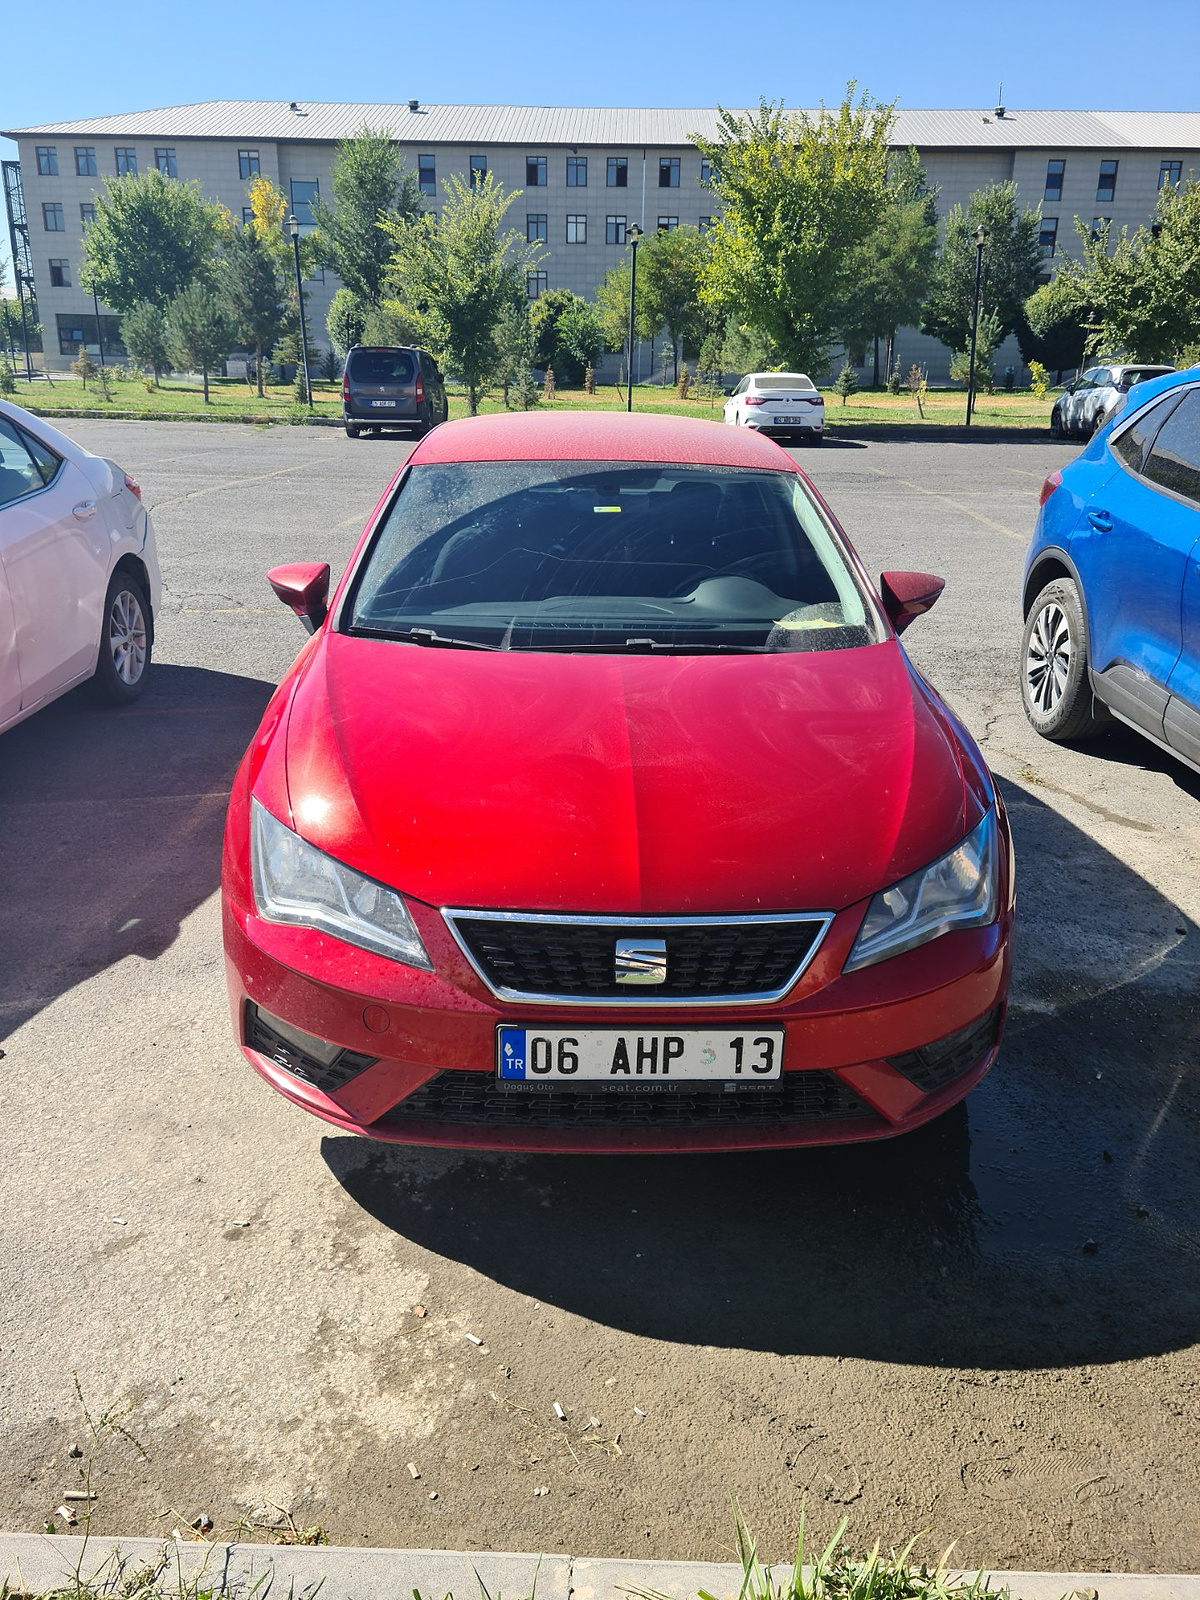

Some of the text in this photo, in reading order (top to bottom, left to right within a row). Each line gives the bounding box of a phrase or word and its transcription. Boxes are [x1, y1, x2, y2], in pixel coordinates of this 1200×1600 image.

[531, 1036, 775, 1075] 06 AHP 13
[506, 1058, 524, 1070] TR
[537, 1083, 554, 1091] Oto
[601, 1083, 679, 1092] seat.com.tr
